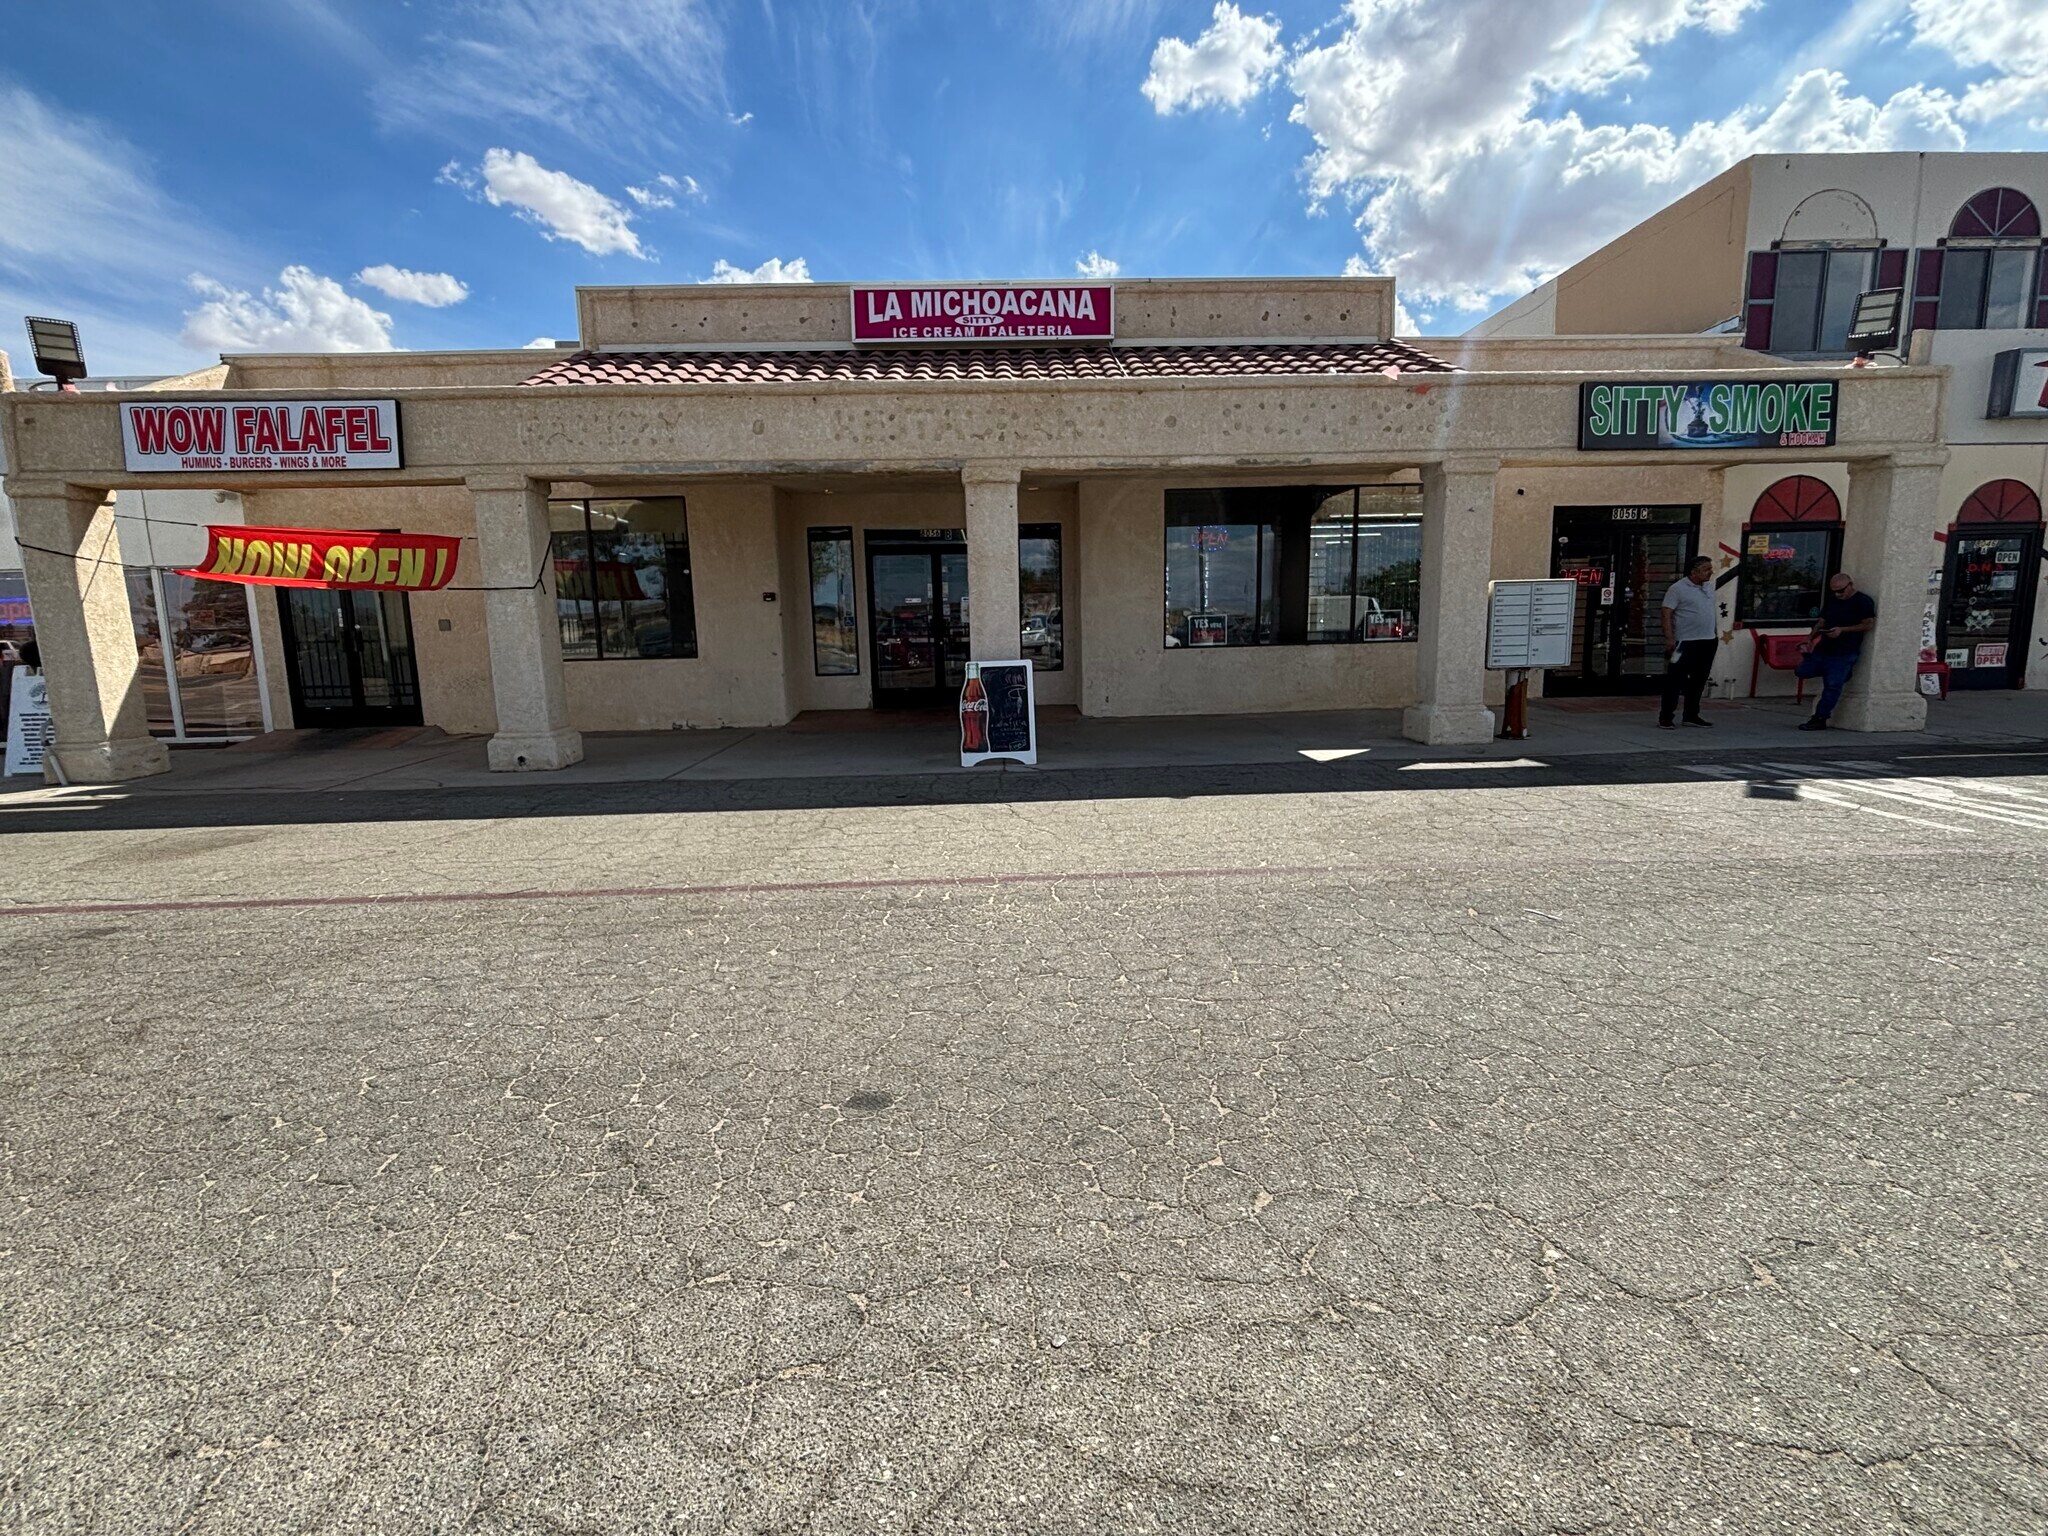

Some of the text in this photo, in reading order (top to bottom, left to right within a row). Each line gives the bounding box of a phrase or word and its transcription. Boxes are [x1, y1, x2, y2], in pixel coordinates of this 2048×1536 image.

[867, 290, 1096, 324] LA MICHOACANA
[962, 316, 997, 325] SITTY
[892, 325, 1073, 338] ICE CREAM / PALETERIA
[1589, 384, 1833, 436] SITTY SMOKE
[129, 406, 392, 454] WOW FALAFEL
[1780, 433, 1826, 446] & HOOKAH
[181, 457, 222, 469] HUMMUS
[230, 457, 272, 469] BURGERS
[279, 456, 309, 468] WINGS
[312, 456, 319, 468] &
[321, 455, 347, 468] MORE
[1612, 508, 1647, 519] 8056 C
[207, 536, 313, 580] NOW
[320, 544, 426, 587] OPEN
[1997, 552, 2019, 562] OPEN
[1194, 619, 1209, 629] YES
[1368, 613, 1385, 624] YES
[1976, 657, 2003, 665] OPEN
